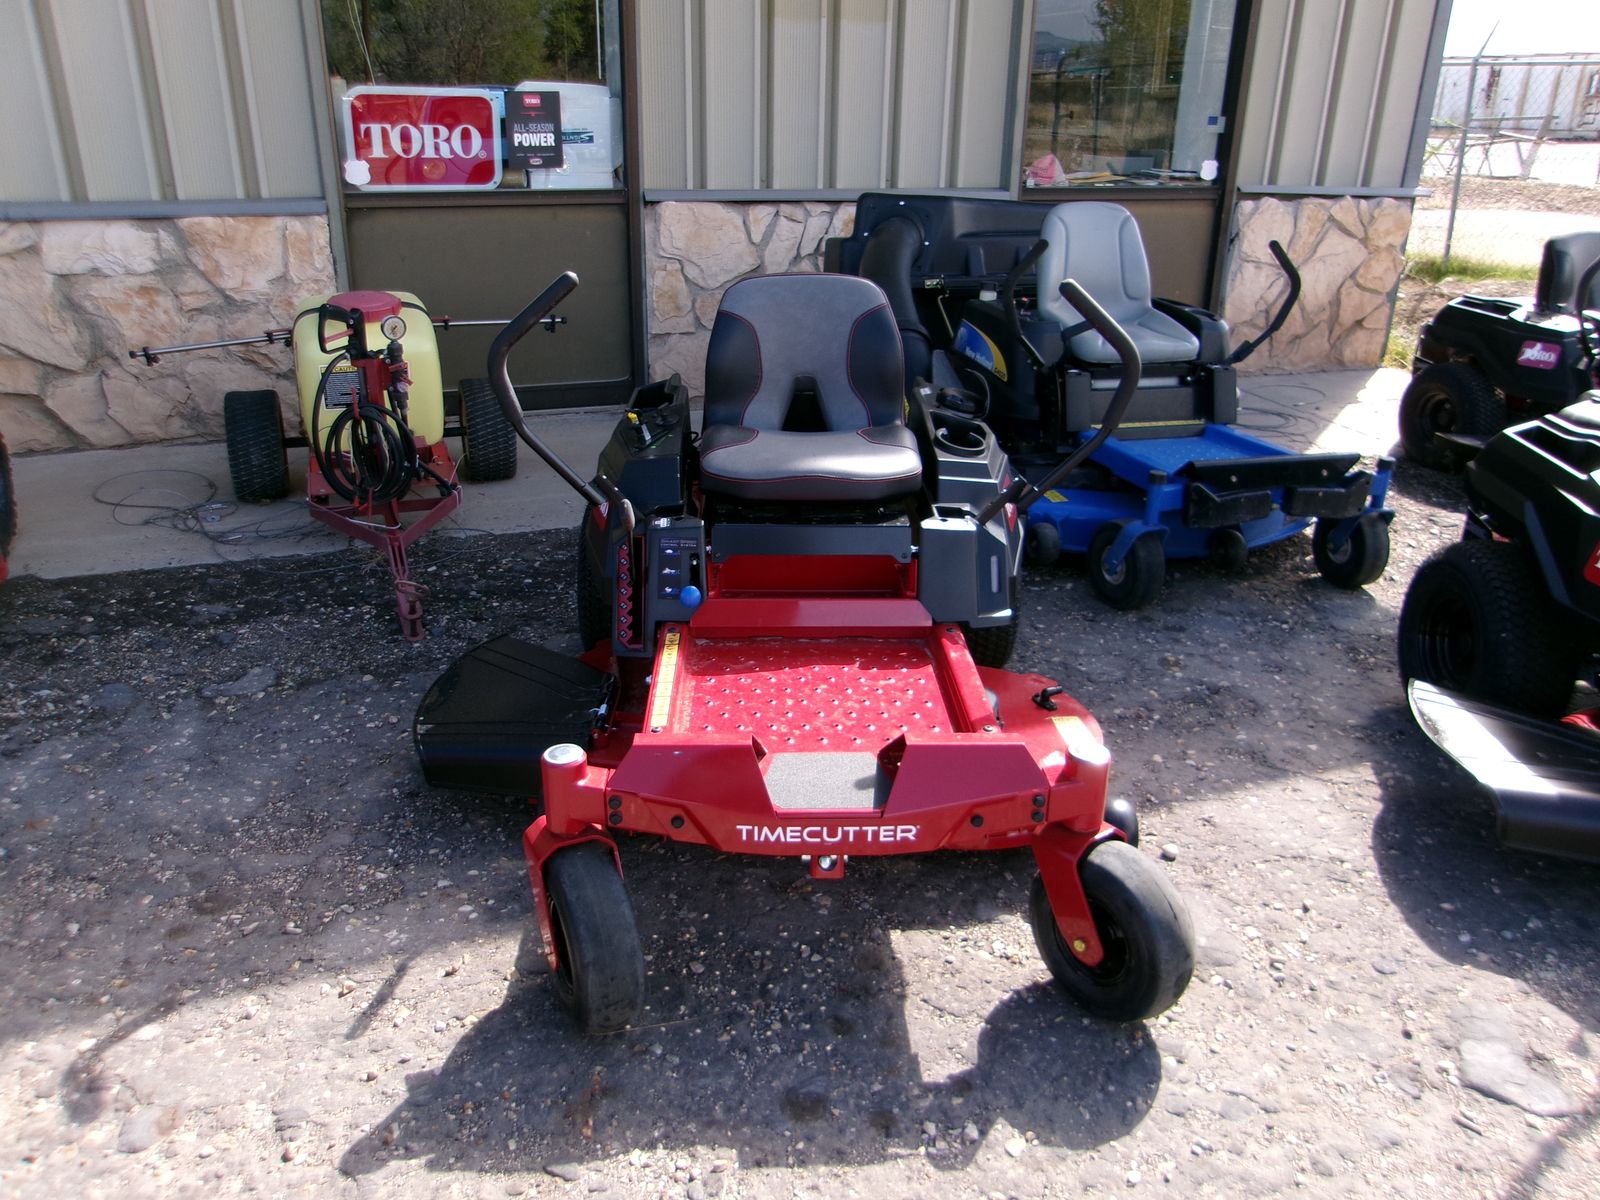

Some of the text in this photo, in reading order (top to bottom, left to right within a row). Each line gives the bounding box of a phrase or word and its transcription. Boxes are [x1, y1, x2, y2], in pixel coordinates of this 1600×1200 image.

[513, 122, 555, 133] ALL-SEASON
[360, 123, 483, 159] TORO
[513, 133, 556, 147] POWER
[736, 825, 918, 842] TIMECUTTER
